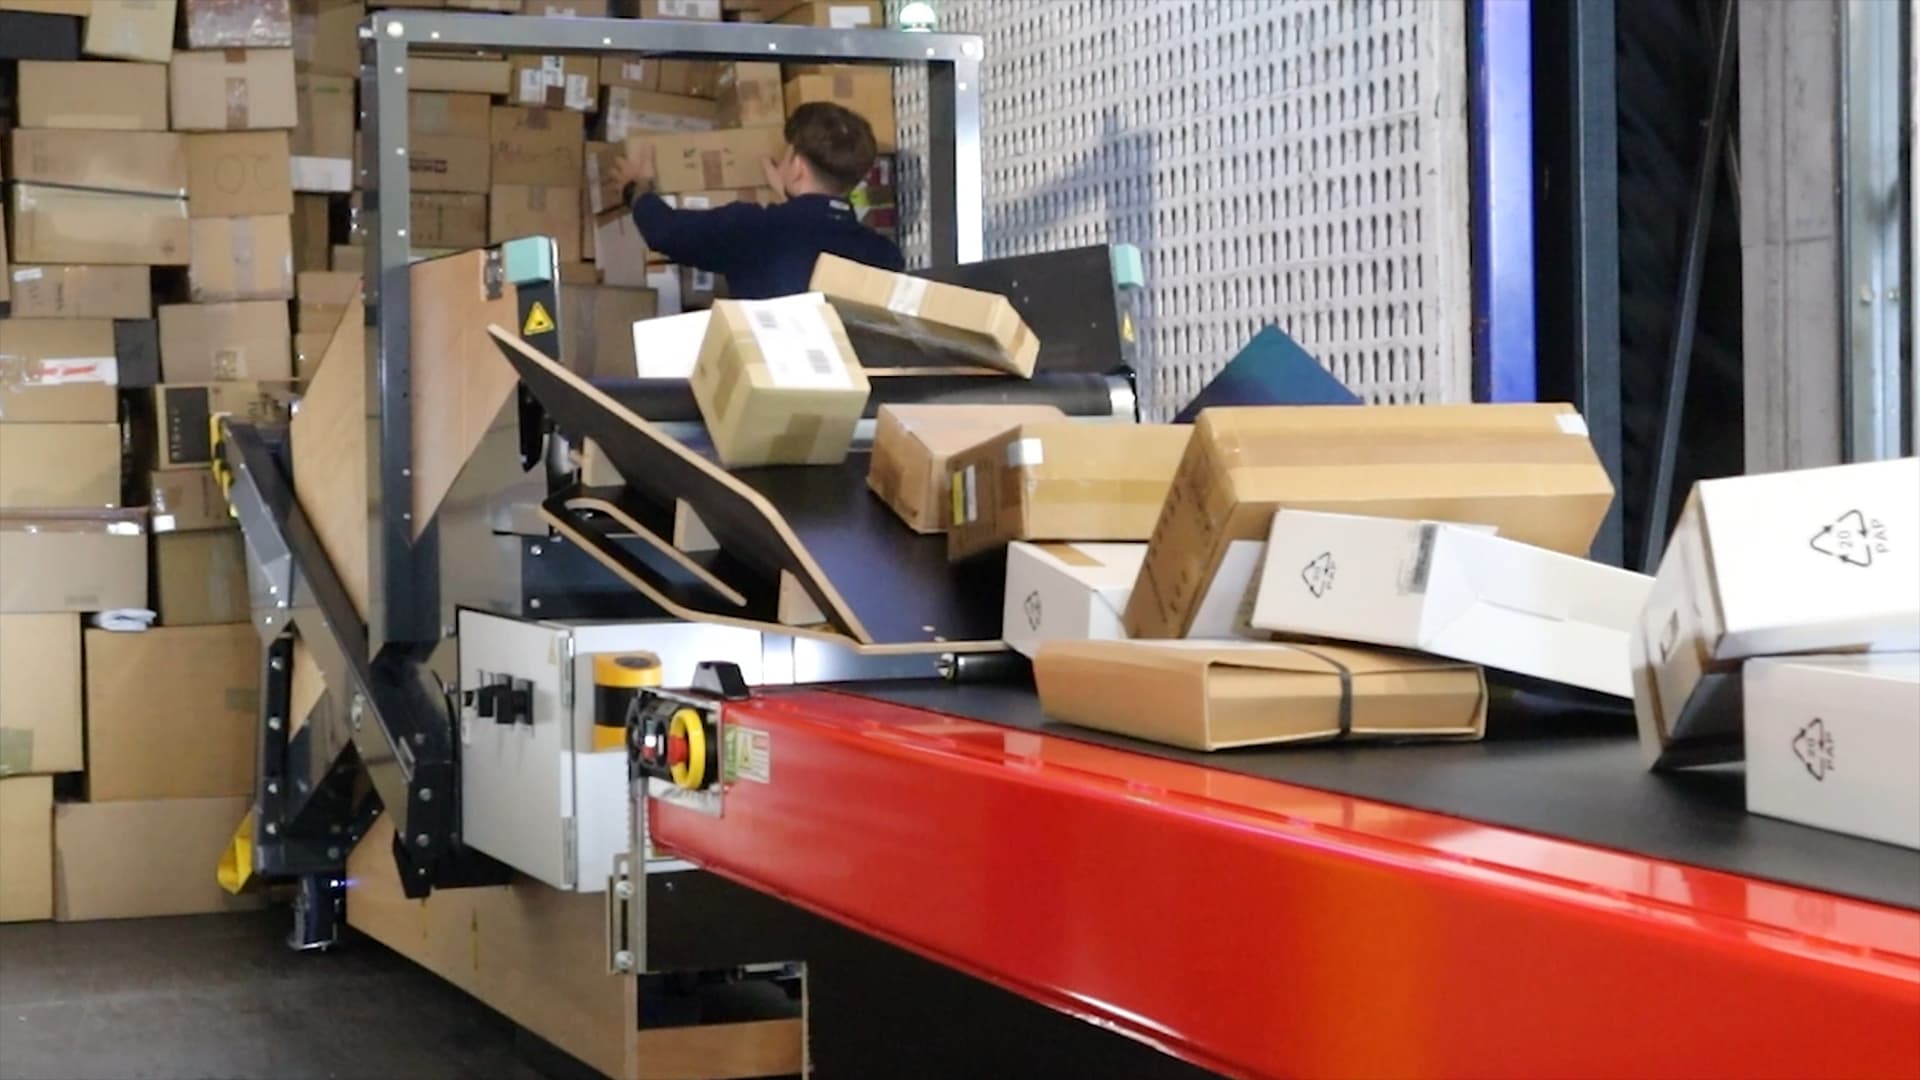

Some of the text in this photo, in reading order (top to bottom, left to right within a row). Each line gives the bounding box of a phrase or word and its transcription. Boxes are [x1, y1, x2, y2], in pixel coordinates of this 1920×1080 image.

[1839, 530, 1853, 549] 20
[1871, 518, 1889, 554] PAP
[1825, 731, 1835, 771] PAP
